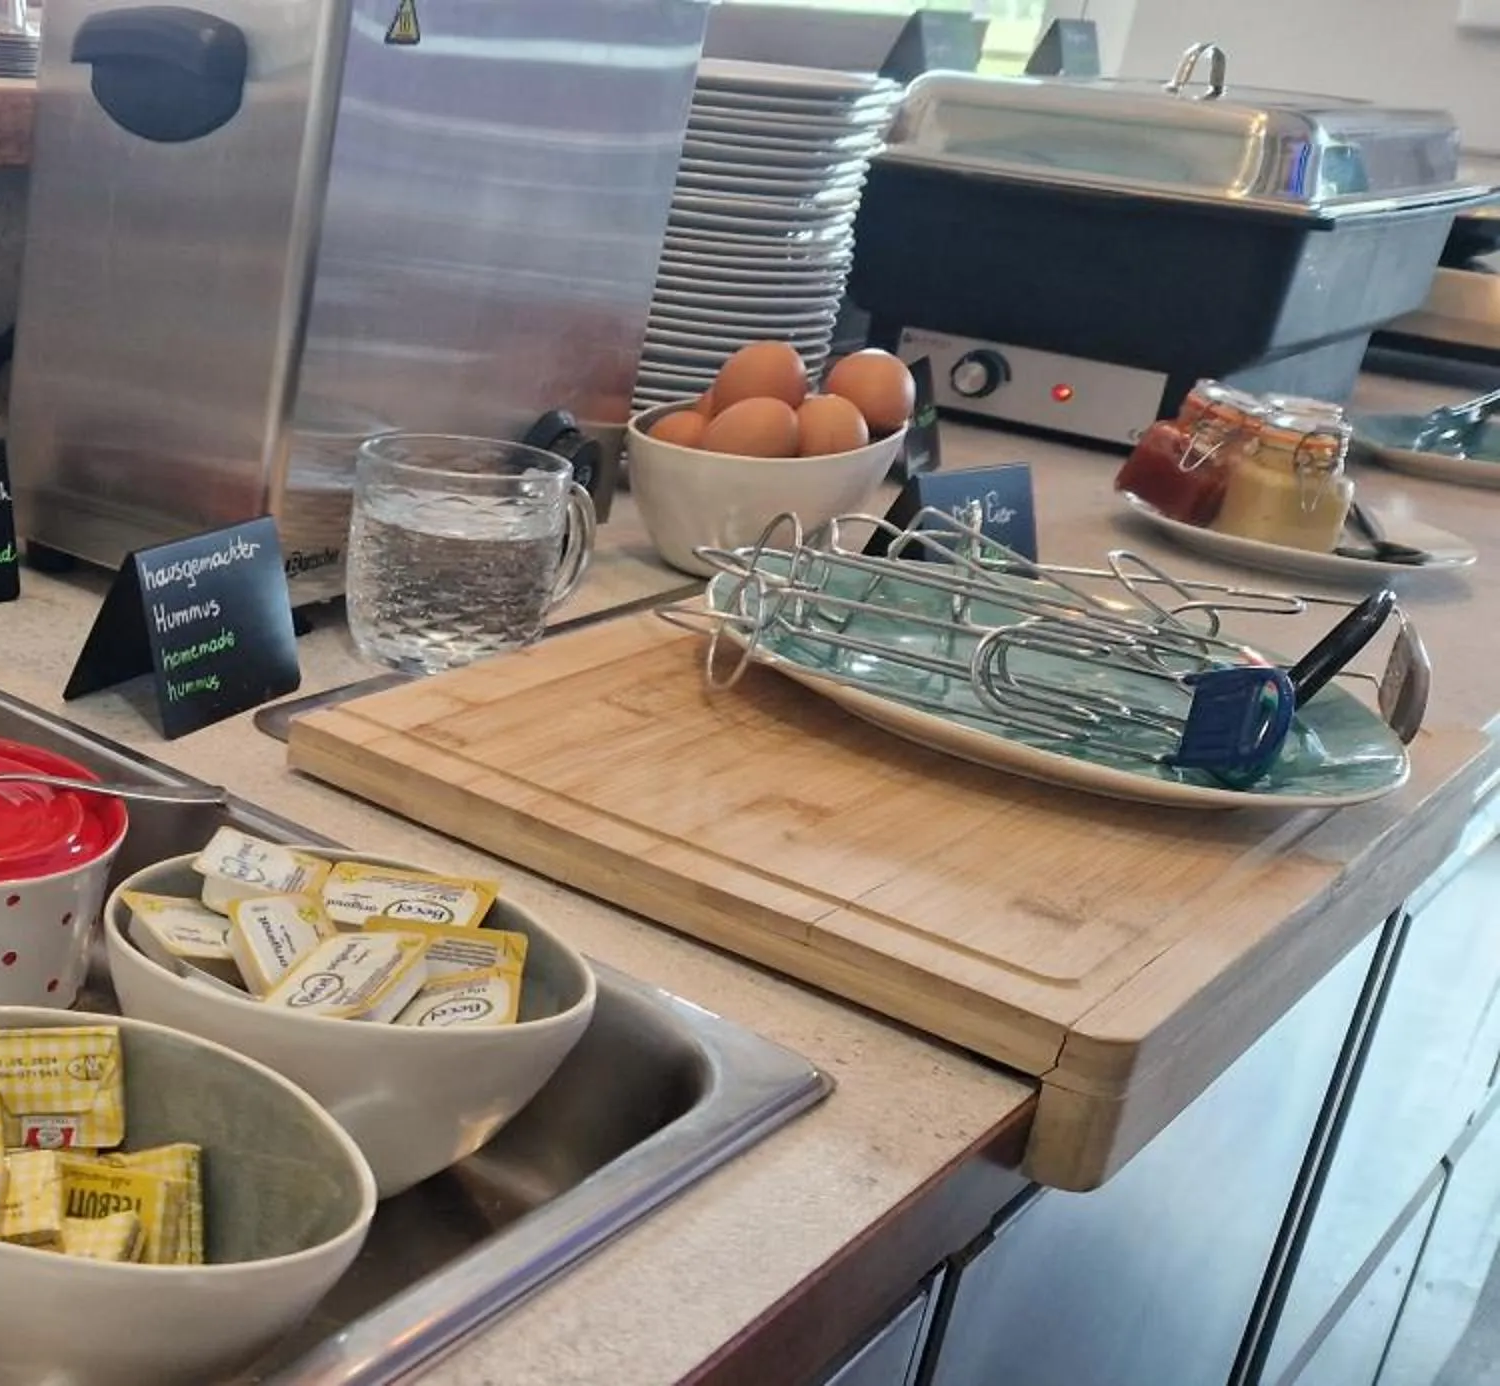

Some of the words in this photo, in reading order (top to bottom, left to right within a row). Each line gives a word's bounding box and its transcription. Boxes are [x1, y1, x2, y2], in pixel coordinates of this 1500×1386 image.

[141, 535, 261, 591] hausgemachter
[152, 597, 222, 634] Hummus
[160, 627, 236, 672] homemade
[165, 672, 222, 702] hummus
[325, 899, 379, 914] original
[394, 903, 446, 921] Becel
